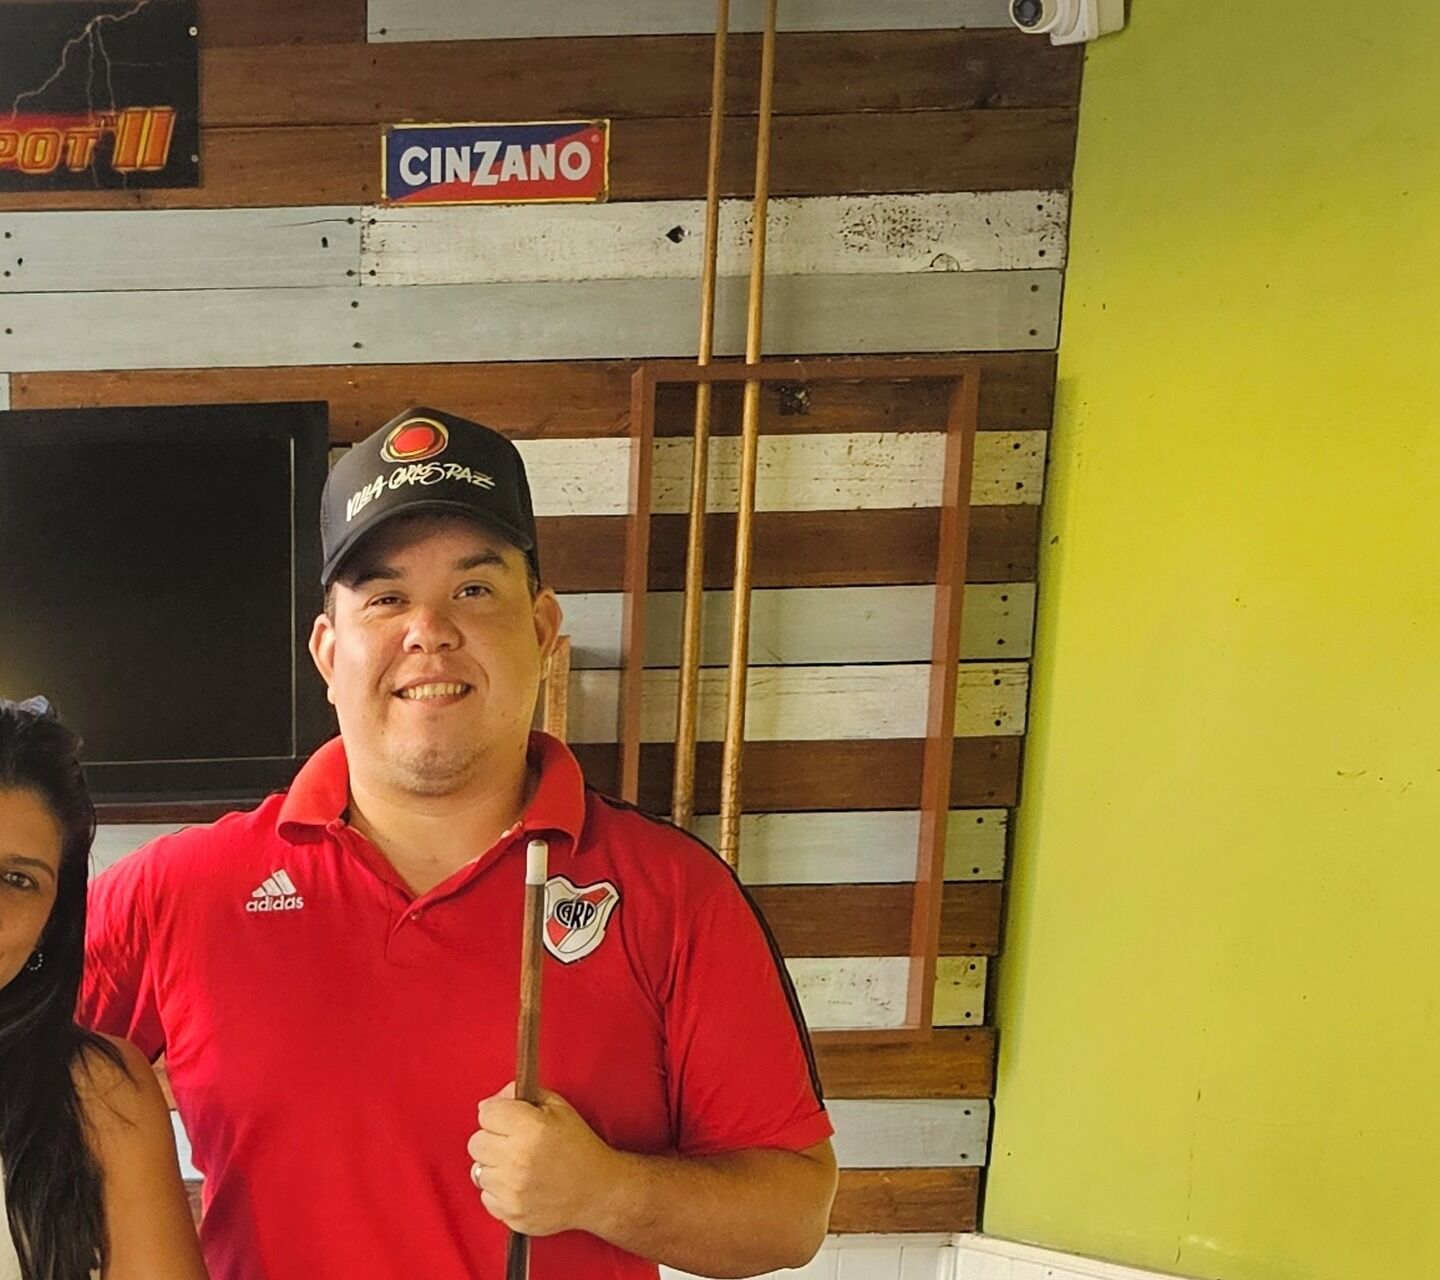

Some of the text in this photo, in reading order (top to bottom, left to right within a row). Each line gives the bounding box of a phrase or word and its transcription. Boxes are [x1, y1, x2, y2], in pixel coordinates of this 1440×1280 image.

[399, 140, 592, 186] CINZANO
[346, 475, 388, 522] VILLA
[388, 461, 446, 490] CARLOS
[245, 895, 305, 912] adidas
